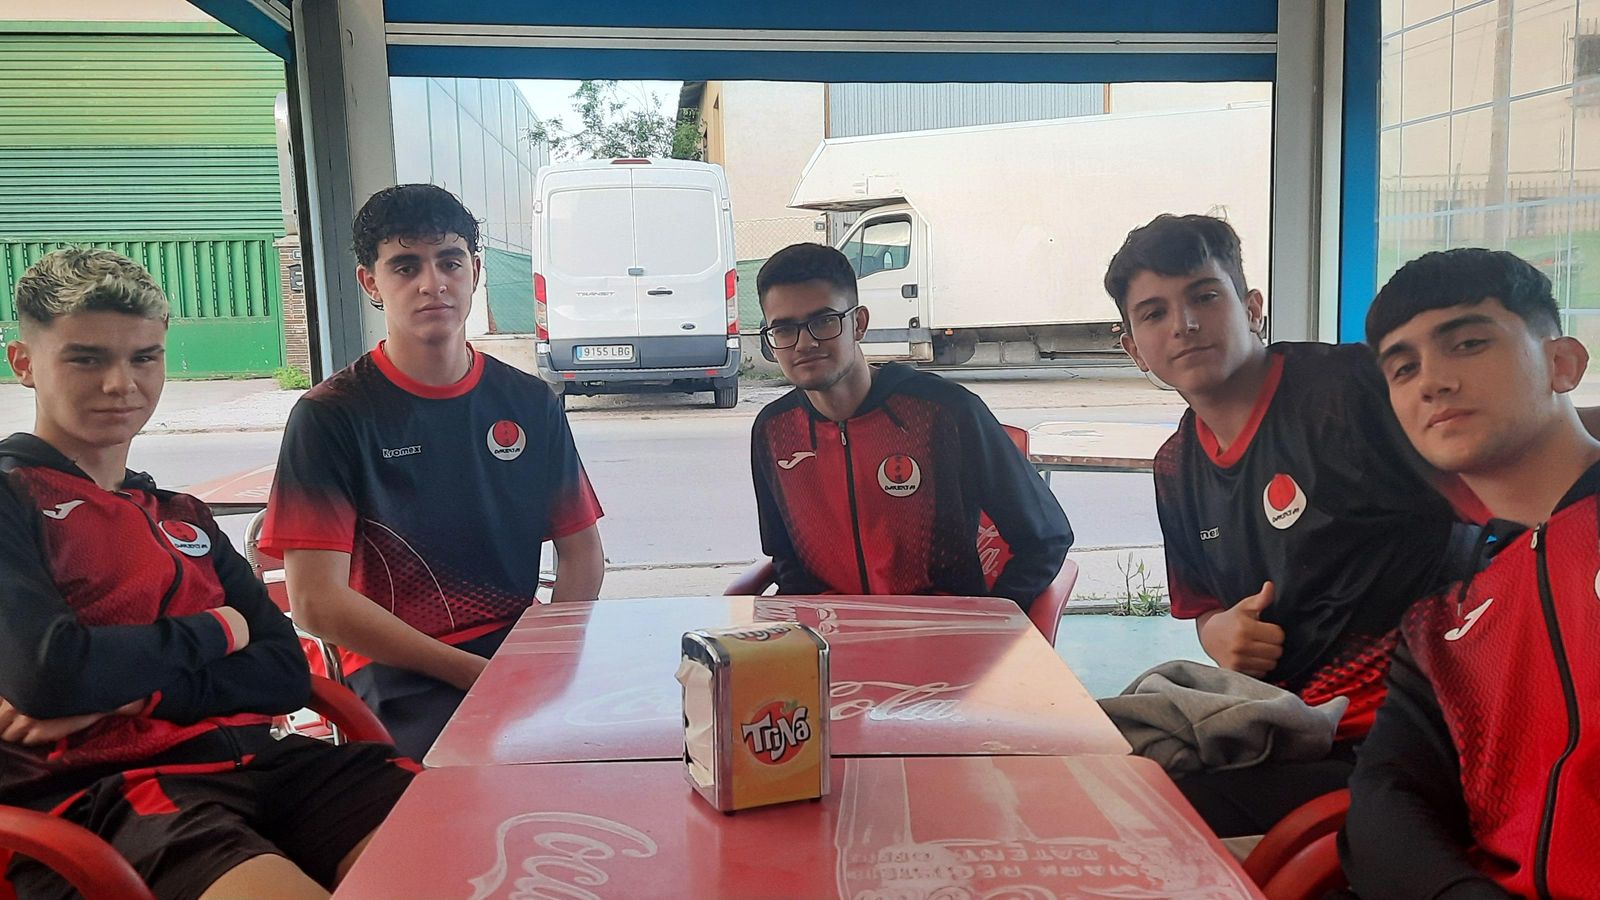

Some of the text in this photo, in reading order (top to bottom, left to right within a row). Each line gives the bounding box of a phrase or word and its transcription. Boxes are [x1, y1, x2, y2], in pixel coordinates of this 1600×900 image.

[584, 347, 630, 357] 9155 LBG
[1036, 864, 1139, 878] MARK
